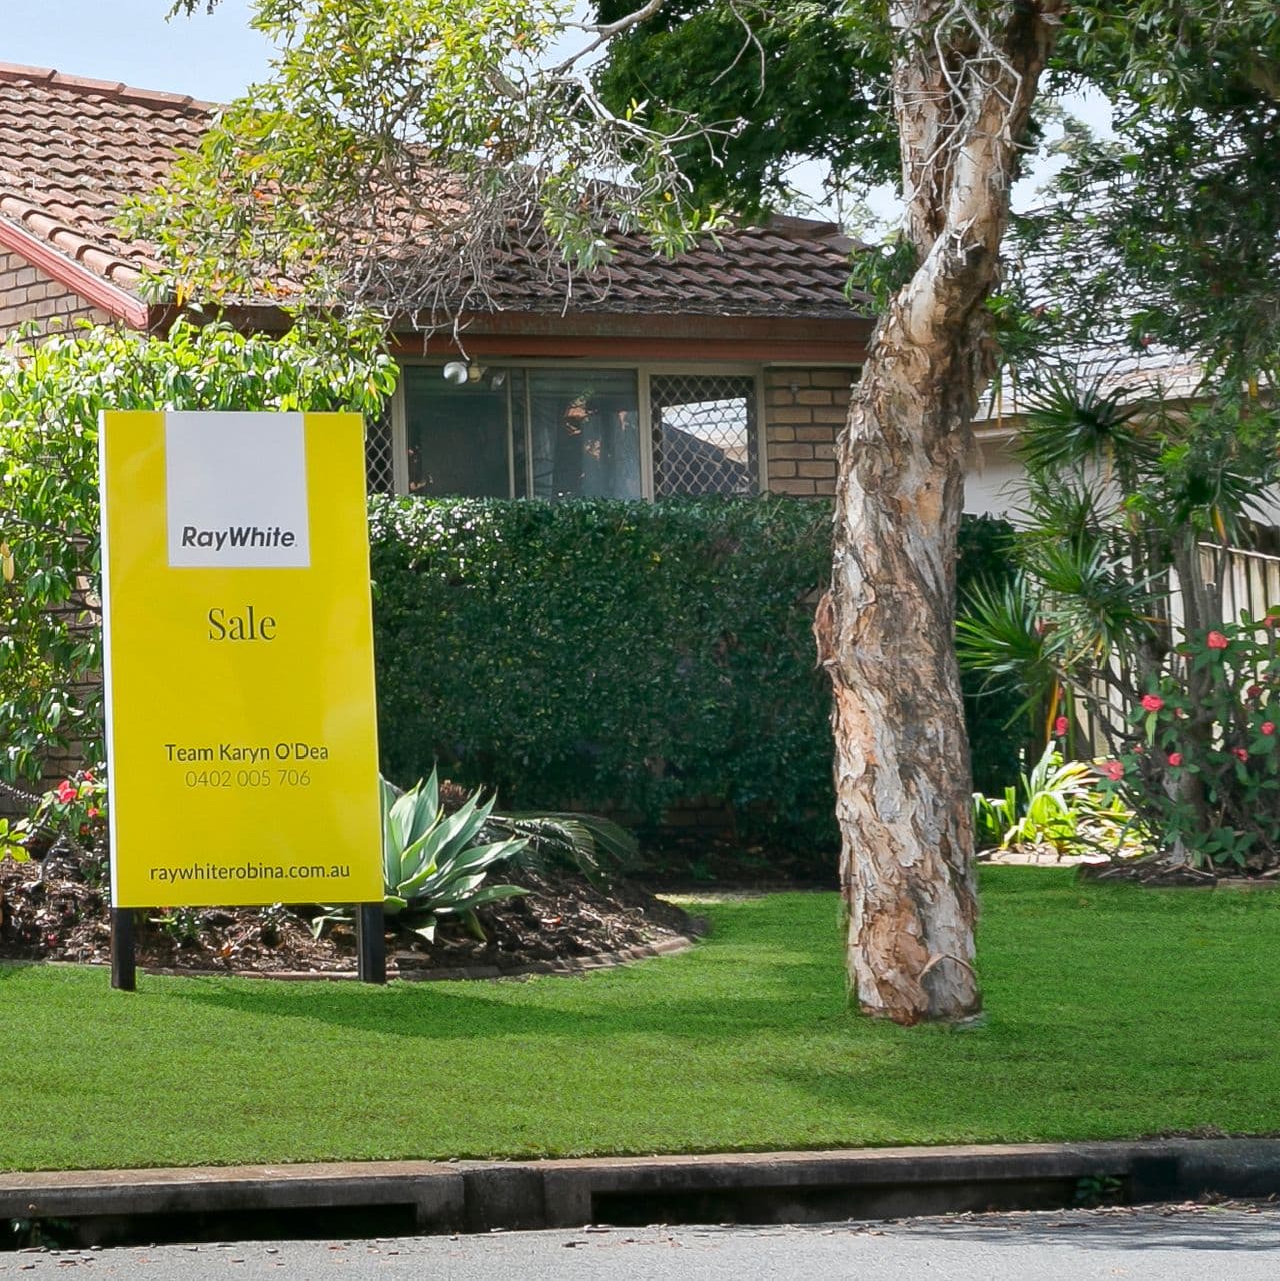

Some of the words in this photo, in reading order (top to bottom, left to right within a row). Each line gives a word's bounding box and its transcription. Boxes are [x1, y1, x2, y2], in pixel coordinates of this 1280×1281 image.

[181, 526, 295, 551] RayWhite
[208, 605, 277, 641] Sale
[164, 744, 214, 761] Team
[219, 743, 270, 764] Karyn
[275, 742, 329, 760] O'Dea
[185, 770, 232, 787] 0402
[237, 770, 271, 787] 005
[278, 769, 311, 786] 706
[150, 862, 350, 884] raywhiterobina.com.au
